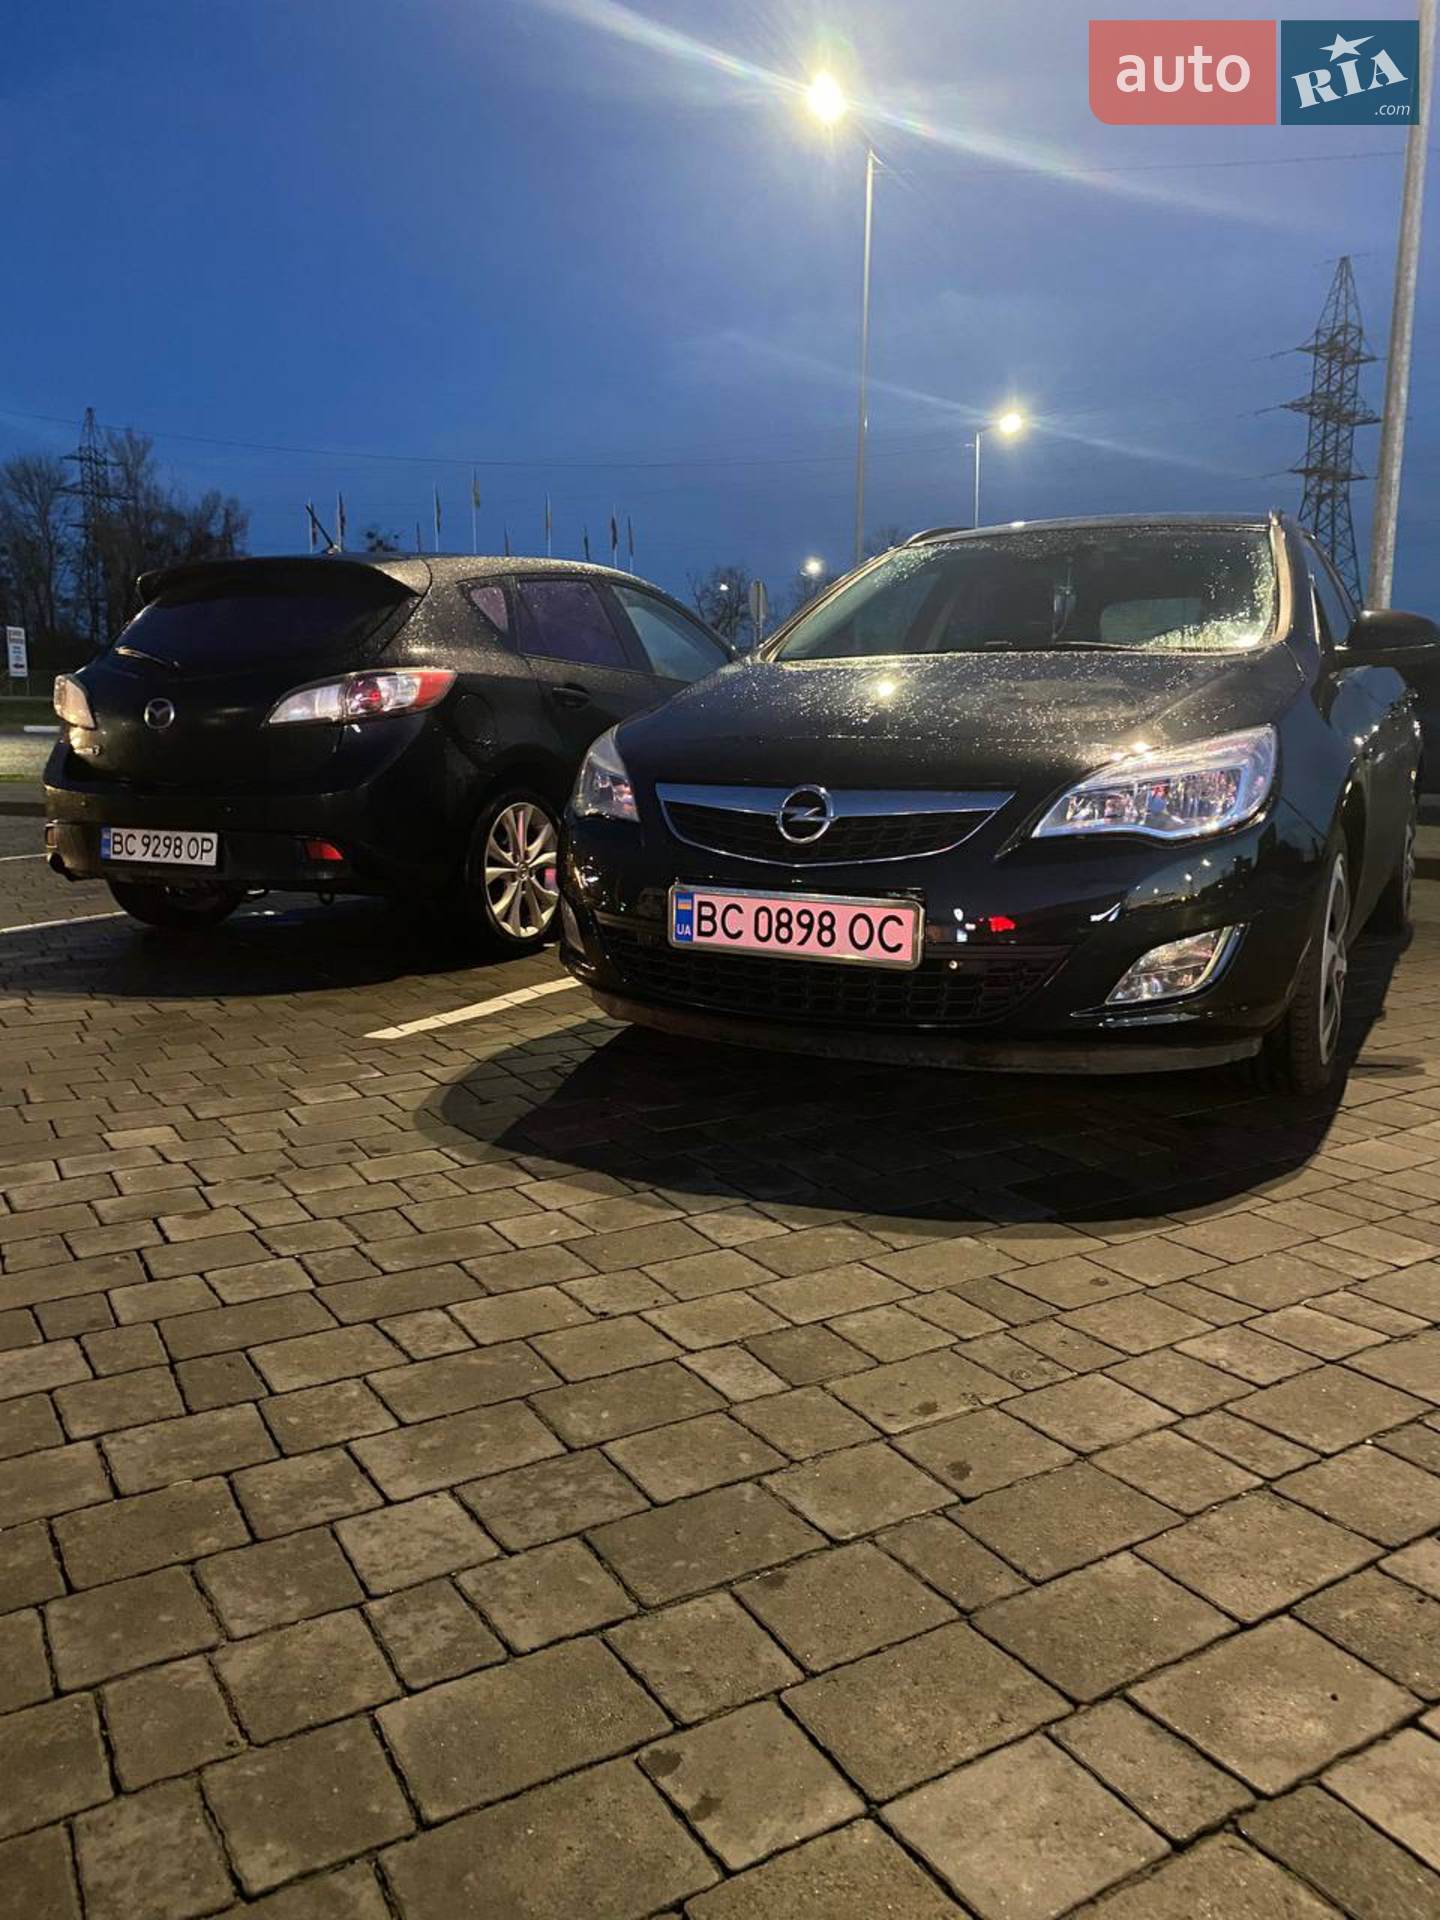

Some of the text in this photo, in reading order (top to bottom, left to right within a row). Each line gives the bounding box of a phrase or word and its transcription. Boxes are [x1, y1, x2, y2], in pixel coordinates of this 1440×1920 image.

[112, 832, 214, 860] BC 9298 OP
[677, 923, 691, 936] UA
[697, 901, 904, 953] BC 0898 OC
